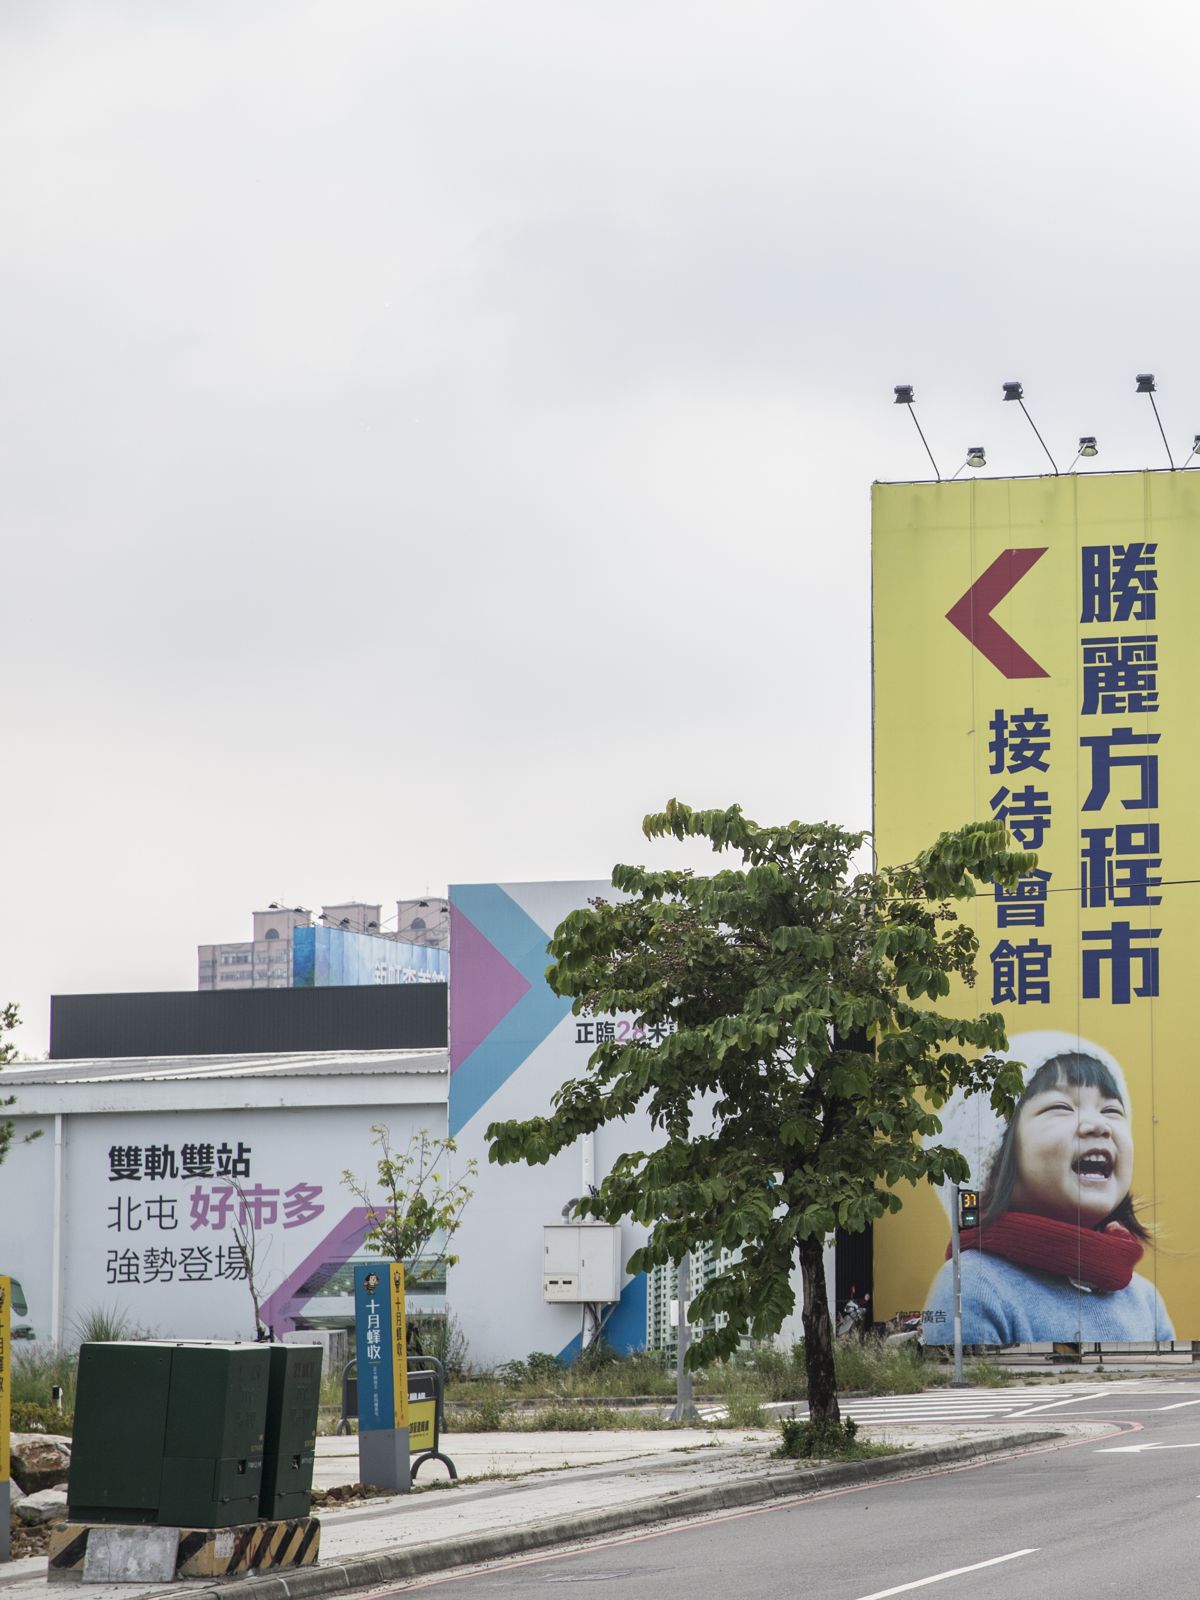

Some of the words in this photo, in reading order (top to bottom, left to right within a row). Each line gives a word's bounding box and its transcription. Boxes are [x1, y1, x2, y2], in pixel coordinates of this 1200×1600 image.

[1079, 542, 1162, 1005] 勝麗方程市
[988, 707, 1053, 1006] 接待會館
[108, 1142, 252, 1182] 雙軌雙站
[107, 1195, 178, 1232] 北屯
[189, 1182, 325, 1231] 好市多
[963, 1193, 977, 1207] 37
[107, 1245, 249, 1284] 強勢登場
[365, 1299, 381, 1360] 十月蜂收
